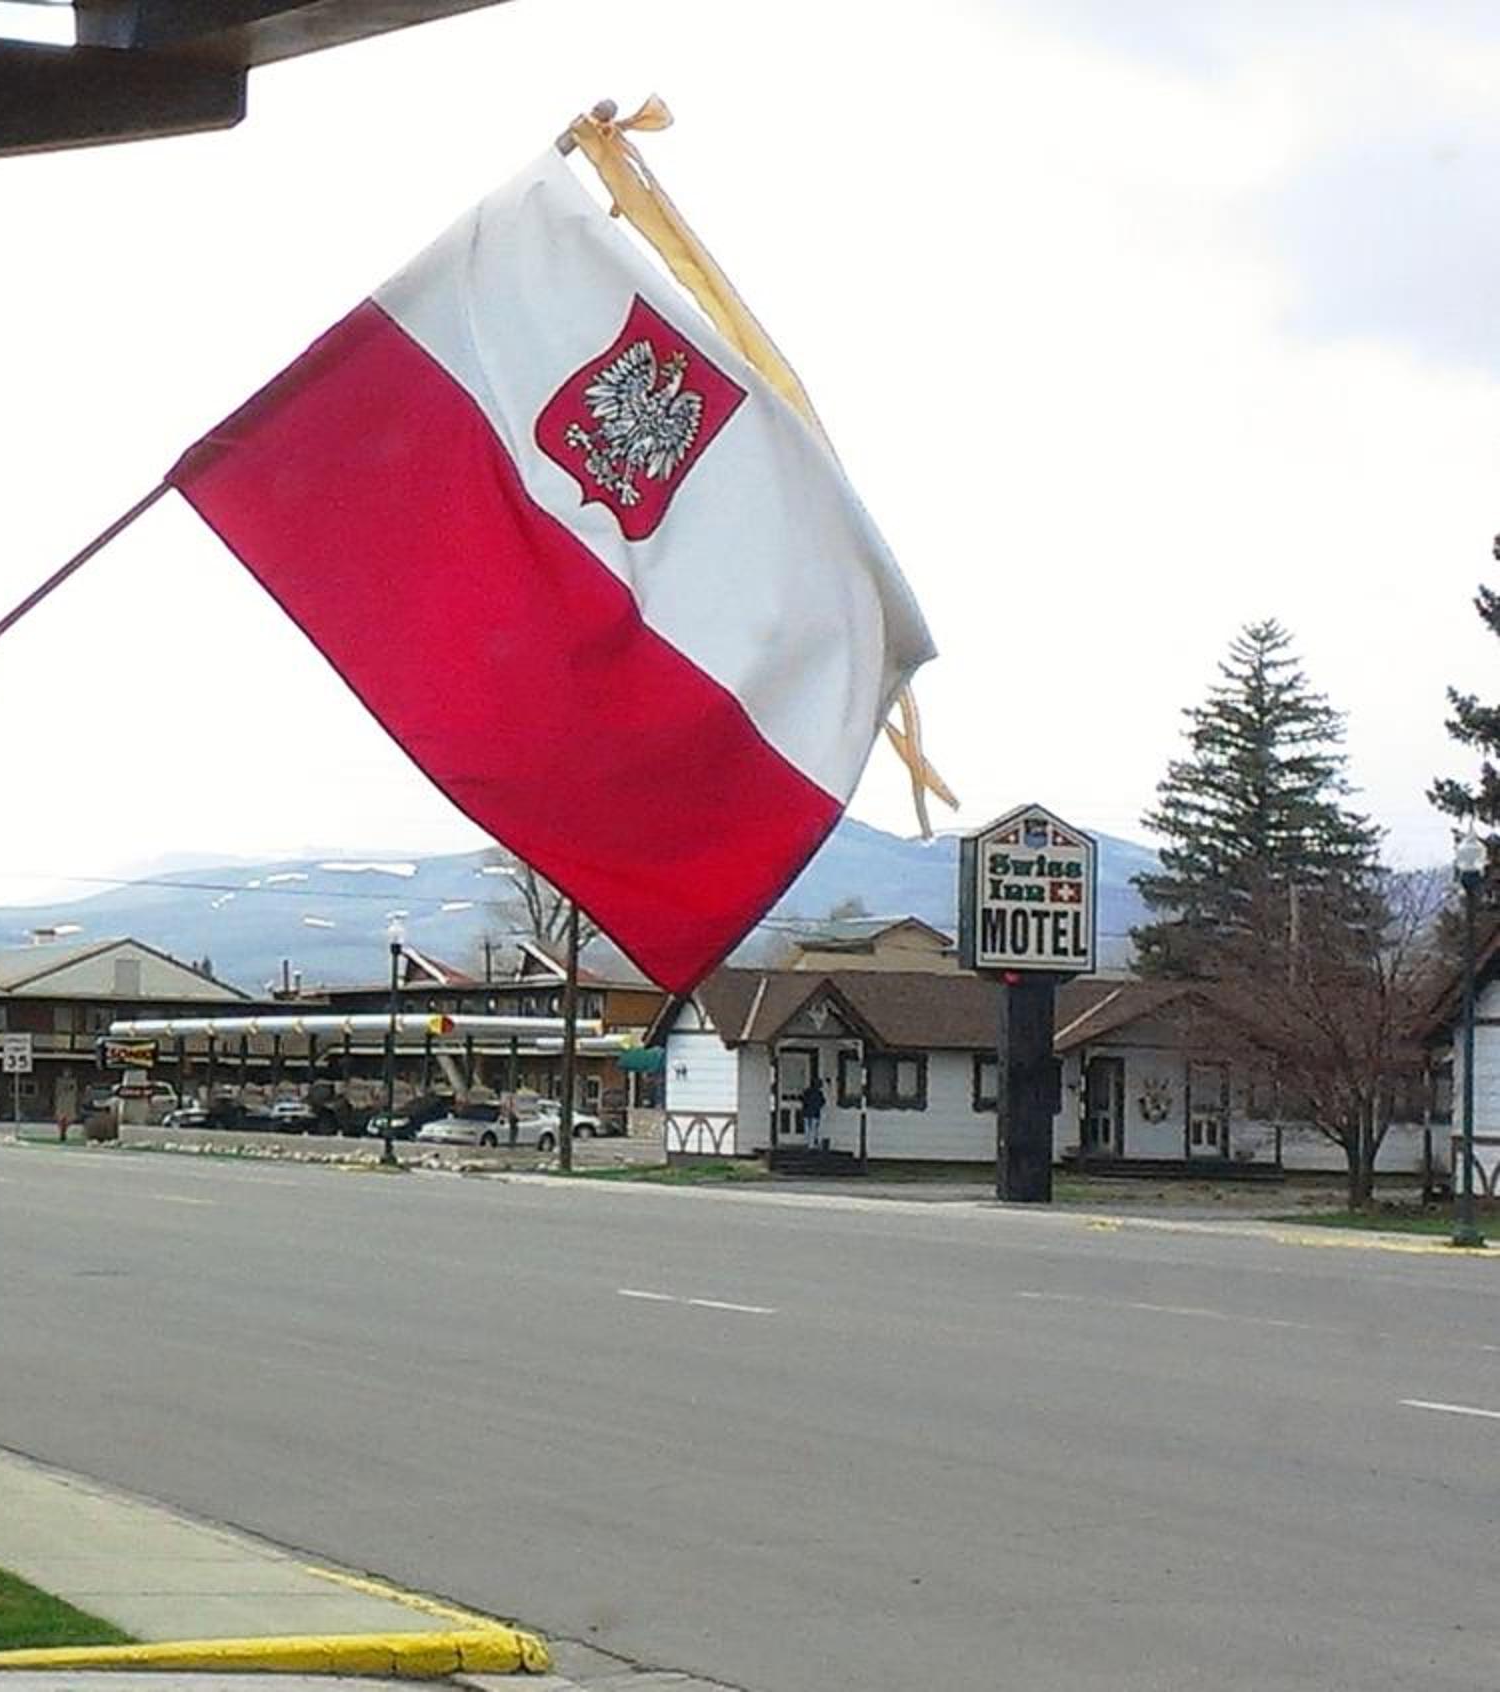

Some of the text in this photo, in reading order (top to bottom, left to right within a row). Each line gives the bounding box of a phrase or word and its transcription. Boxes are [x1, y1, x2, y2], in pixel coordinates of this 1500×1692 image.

[989, 853, 1082, 878] Swiss
[989, 878, 1045, 902] Inn
[982, 908, 1087, 956] MOTEL
